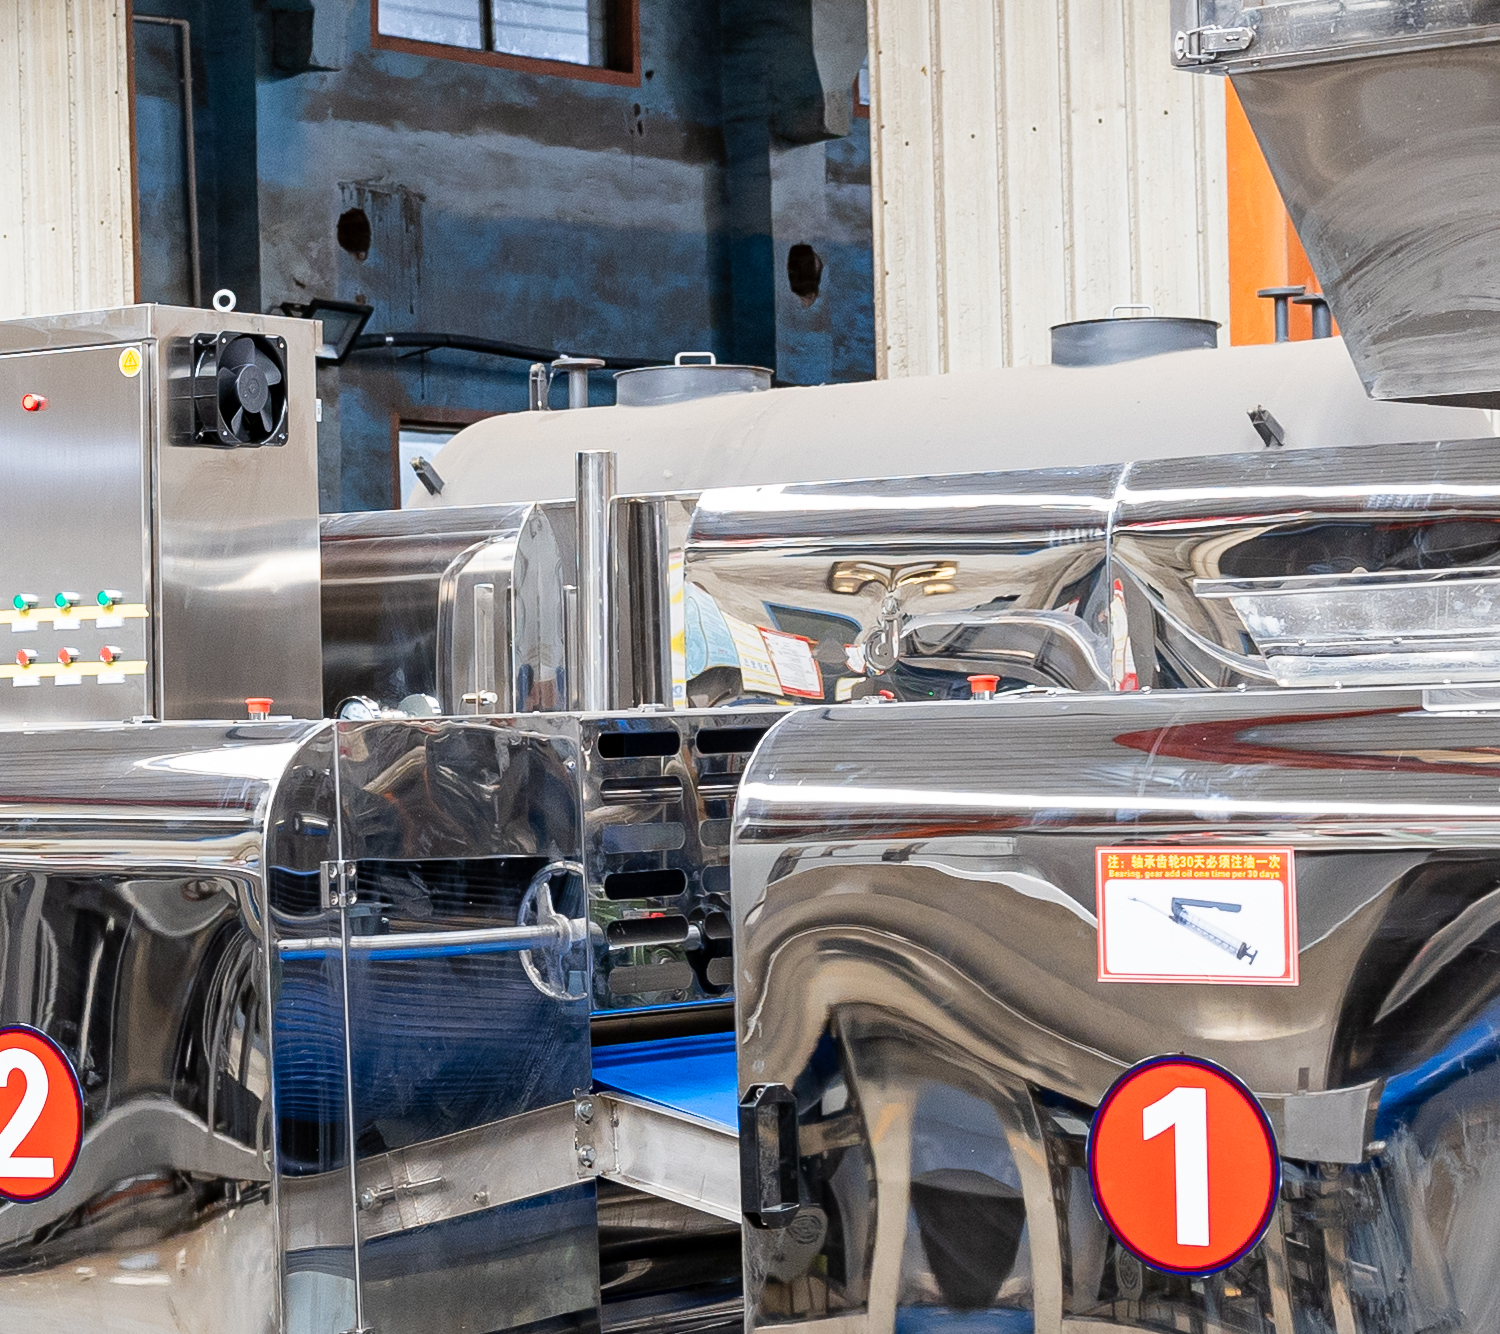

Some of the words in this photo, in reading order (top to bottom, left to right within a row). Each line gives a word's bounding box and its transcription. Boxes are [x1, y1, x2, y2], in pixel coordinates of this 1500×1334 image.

[1108, 869, 1143, 879] Bearing,
[1144, 870, 1163, 879] gear
[1164, 869, 1180, 878] add
[1181, 869, 1193, 878] oil
[1193, 870, 1210, 878] one
[1211, 869, 1230, 878] time
[1231, 870, 1246, 879] per
[1247, 869, 1257, 878] 30
[1259, 869, 1280, 879] days
[1143, 1087, 1209, 1246] 1
